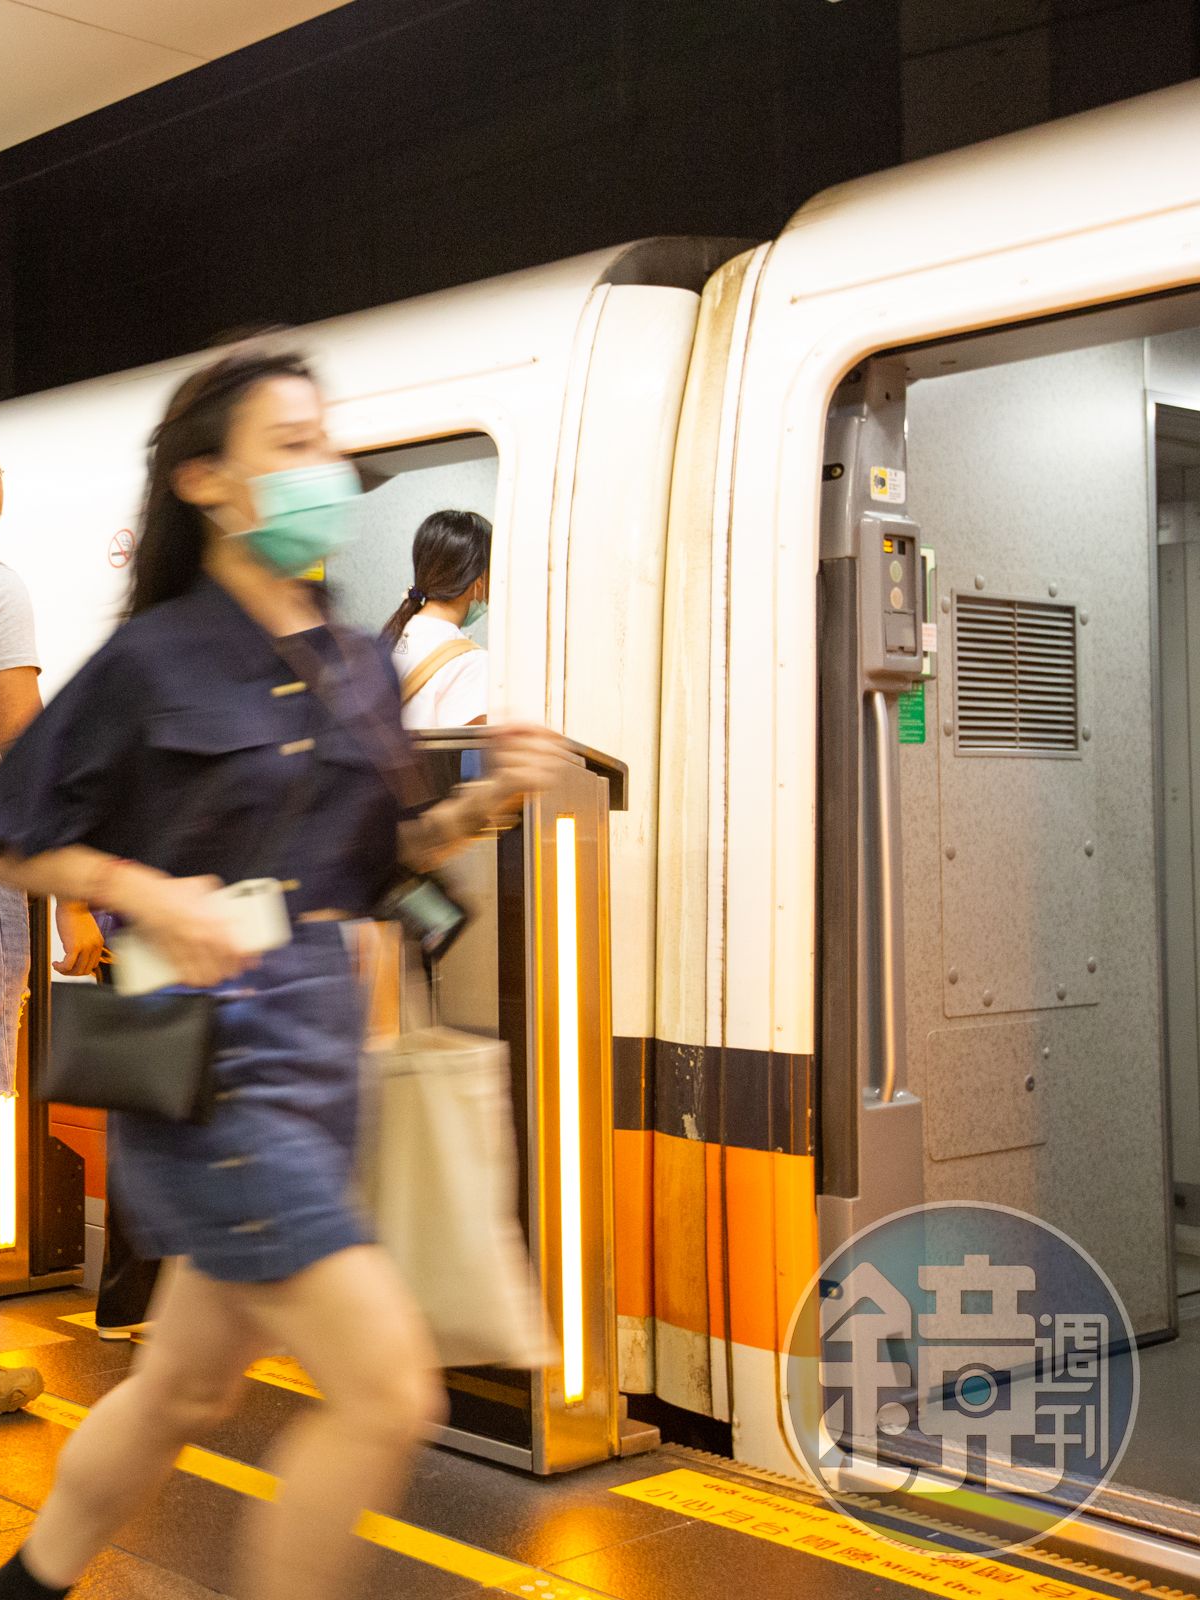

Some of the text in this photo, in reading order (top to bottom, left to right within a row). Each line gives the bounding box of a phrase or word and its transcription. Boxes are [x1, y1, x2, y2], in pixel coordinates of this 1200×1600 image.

[643, 1487, 982, 1596] 小心月台間隙 Mind the
